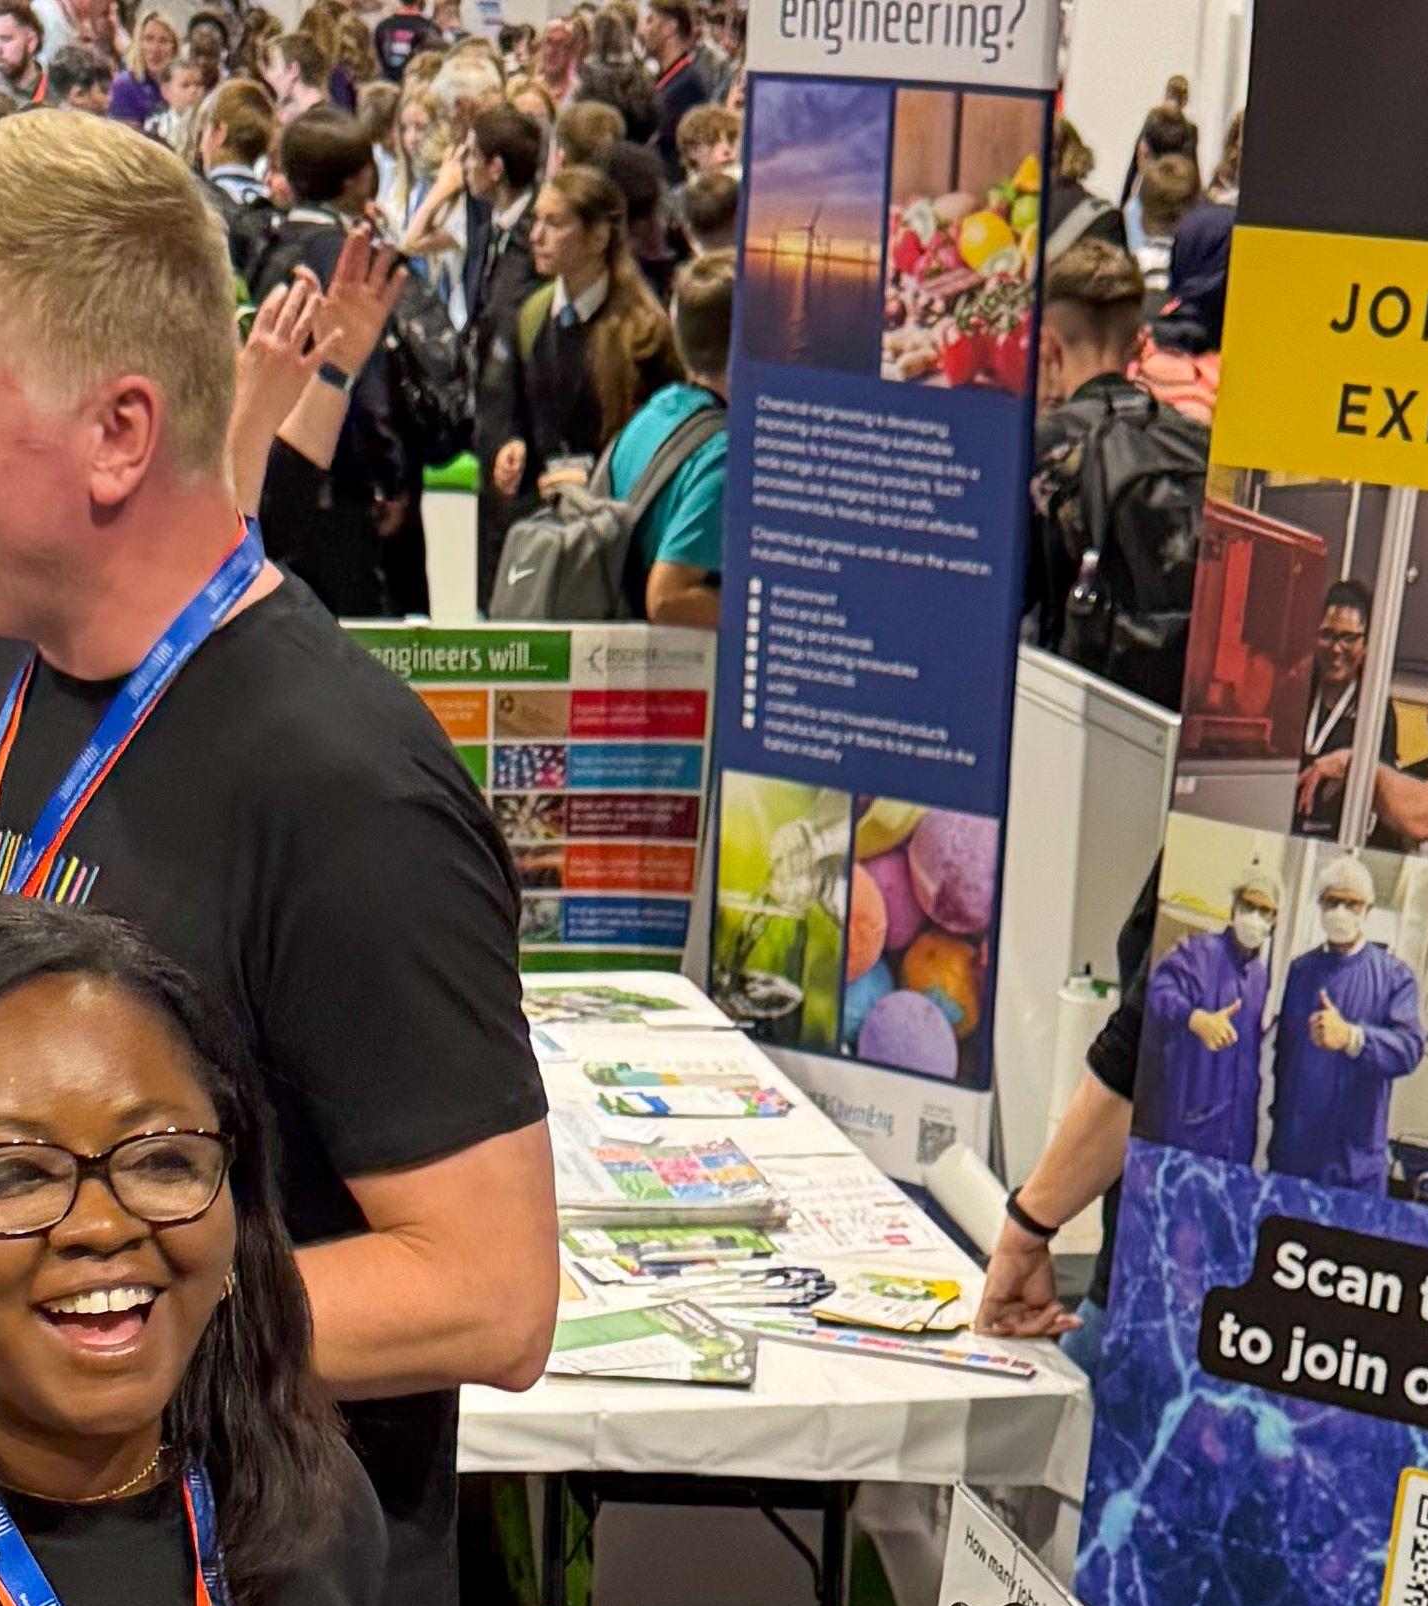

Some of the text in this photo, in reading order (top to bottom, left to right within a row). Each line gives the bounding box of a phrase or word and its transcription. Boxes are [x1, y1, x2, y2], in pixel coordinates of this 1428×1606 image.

[779, 0, 1026, 64] engineering?
[1272, 1240, 1403, 1317] Scan
[1218, 1311, 1274, 1368] to
[1281, 1326, 1390, 1399] join
[963, 1524, 988, 1564] How
